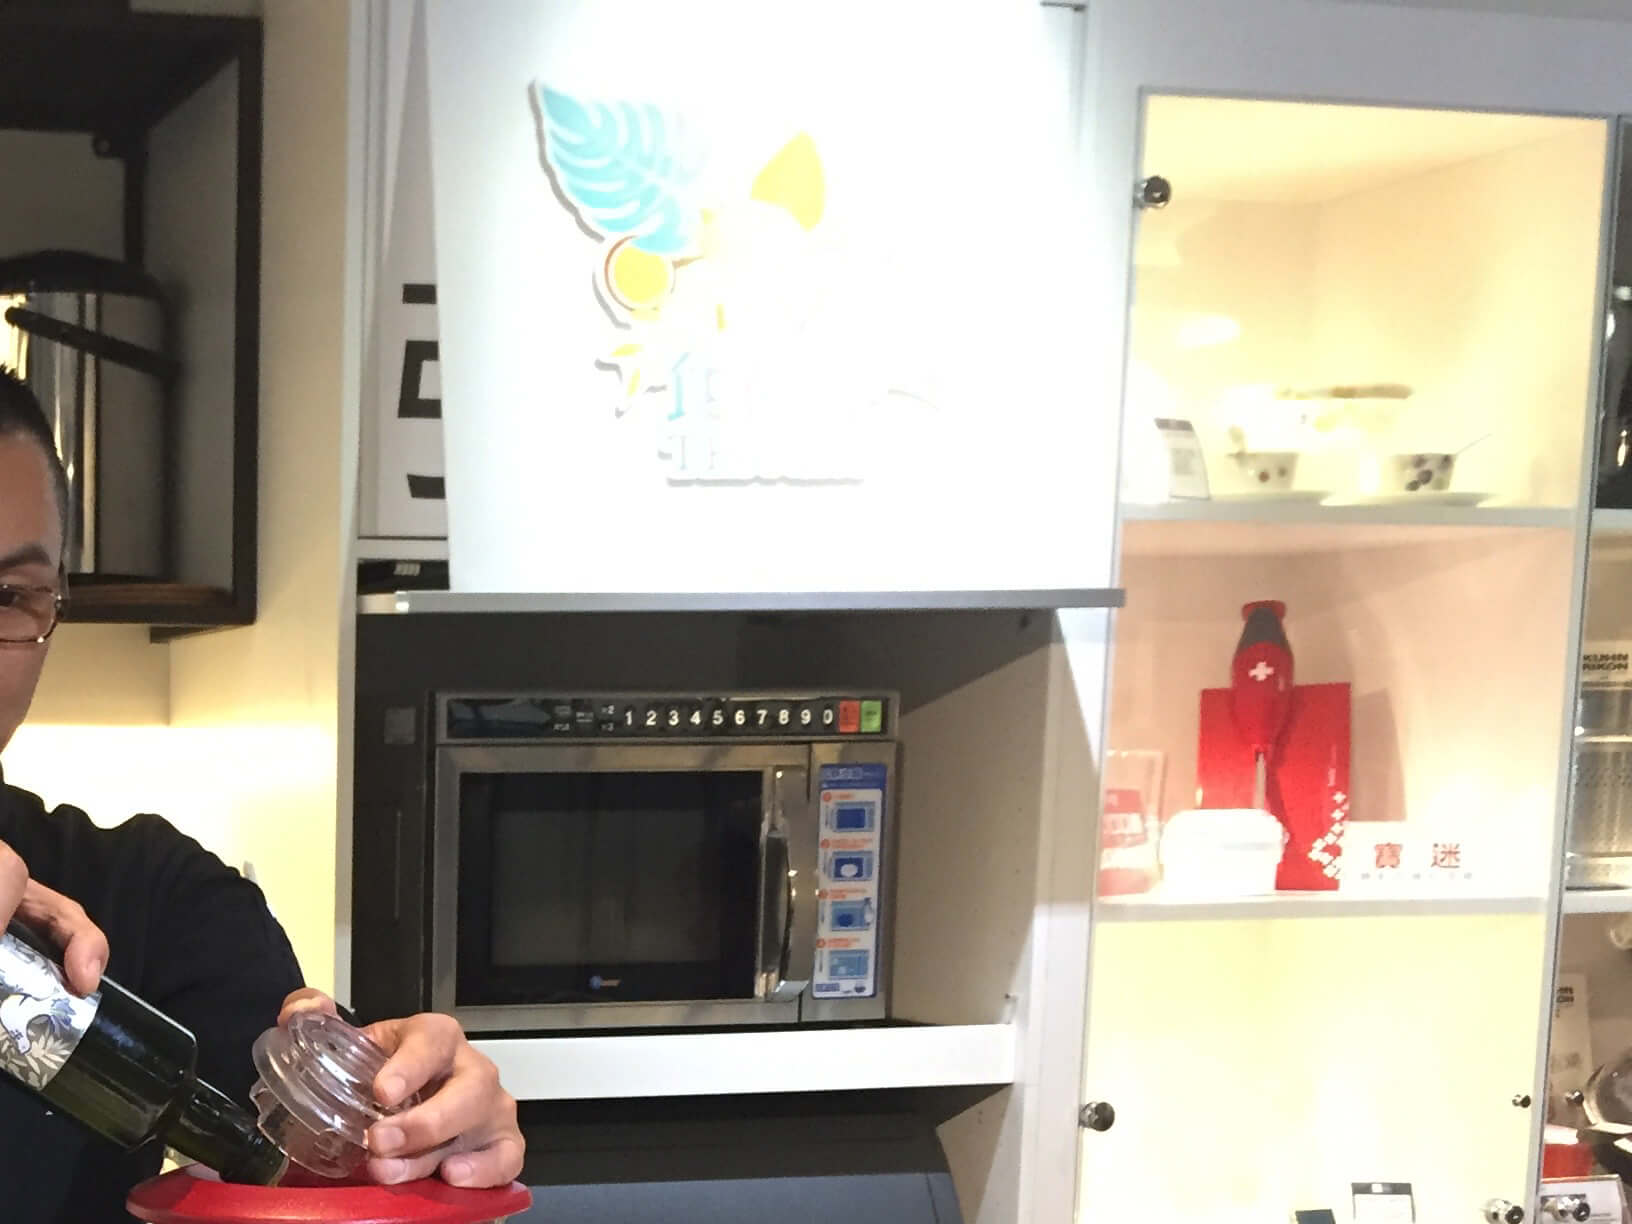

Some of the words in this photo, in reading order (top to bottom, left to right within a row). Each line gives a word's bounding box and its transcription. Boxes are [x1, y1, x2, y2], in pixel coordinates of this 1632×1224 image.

[625, 710, 633, 726] 1
[646, 709, 657, 726] 2
[668, 709, 680, 726] 3
[690, 709, 702, 725] 4
[712, 709, 724, 725] 5
[734, 709, 746, 725] 6
[756, 709, 768, 725] 7
[778, 709, 790, 725] 8
[800, 709, 811, 725] 9
[823, 709, 834, 725] 0
